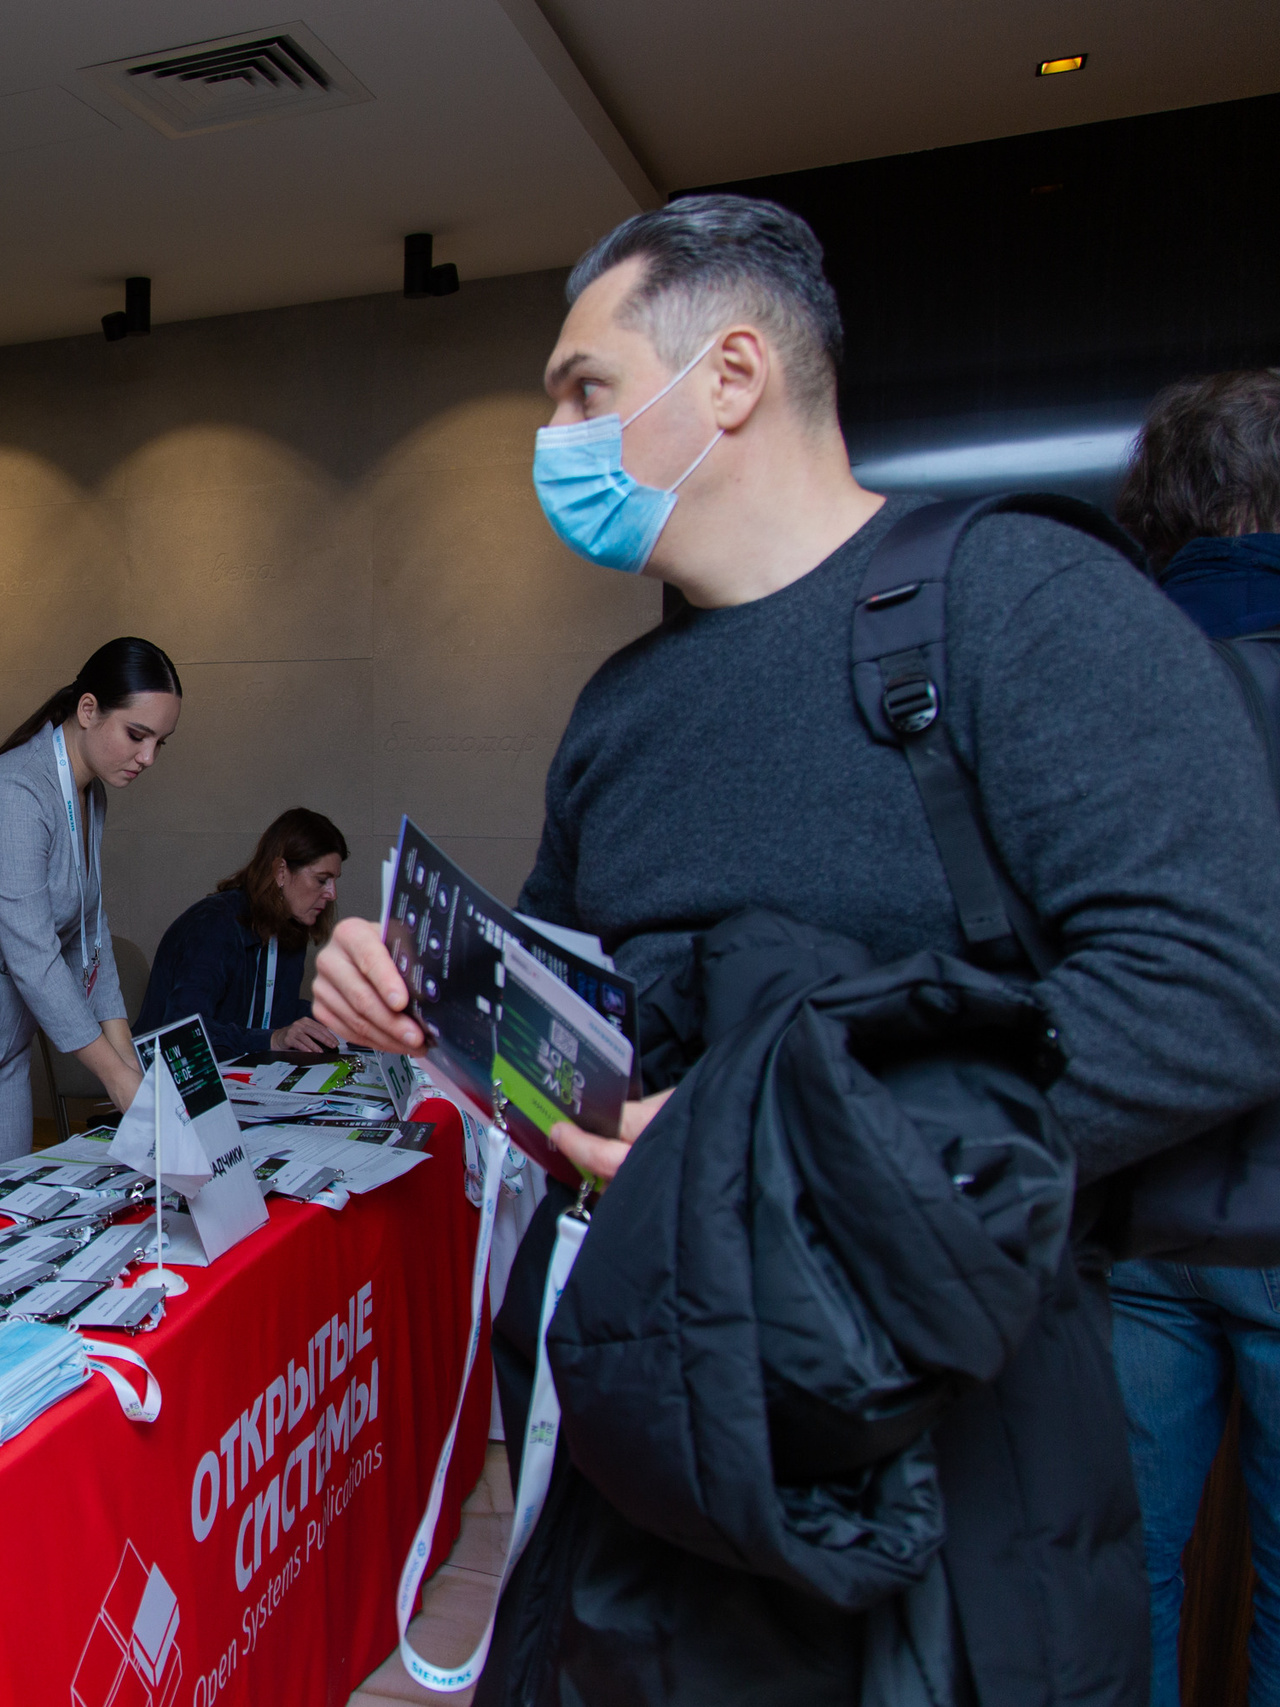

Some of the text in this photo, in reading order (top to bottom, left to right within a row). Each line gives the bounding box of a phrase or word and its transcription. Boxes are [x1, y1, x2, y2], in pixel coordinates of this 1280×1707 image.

[165, 1044, 182, 1062] LOW
[173, 1065, 194, 1085] CODE
[543, 1073, 582, 1115] LOW
[191, 1280, 373, 1543] ОТКРЫТЫЕ
[235, 1357, 379, 1593] СИСТЕМЫ
[193, 1638, 237, 1707] Open
[242, 1542, 301, 1653] Systems
[411, 1660, 473, 1688] SIEMENS
